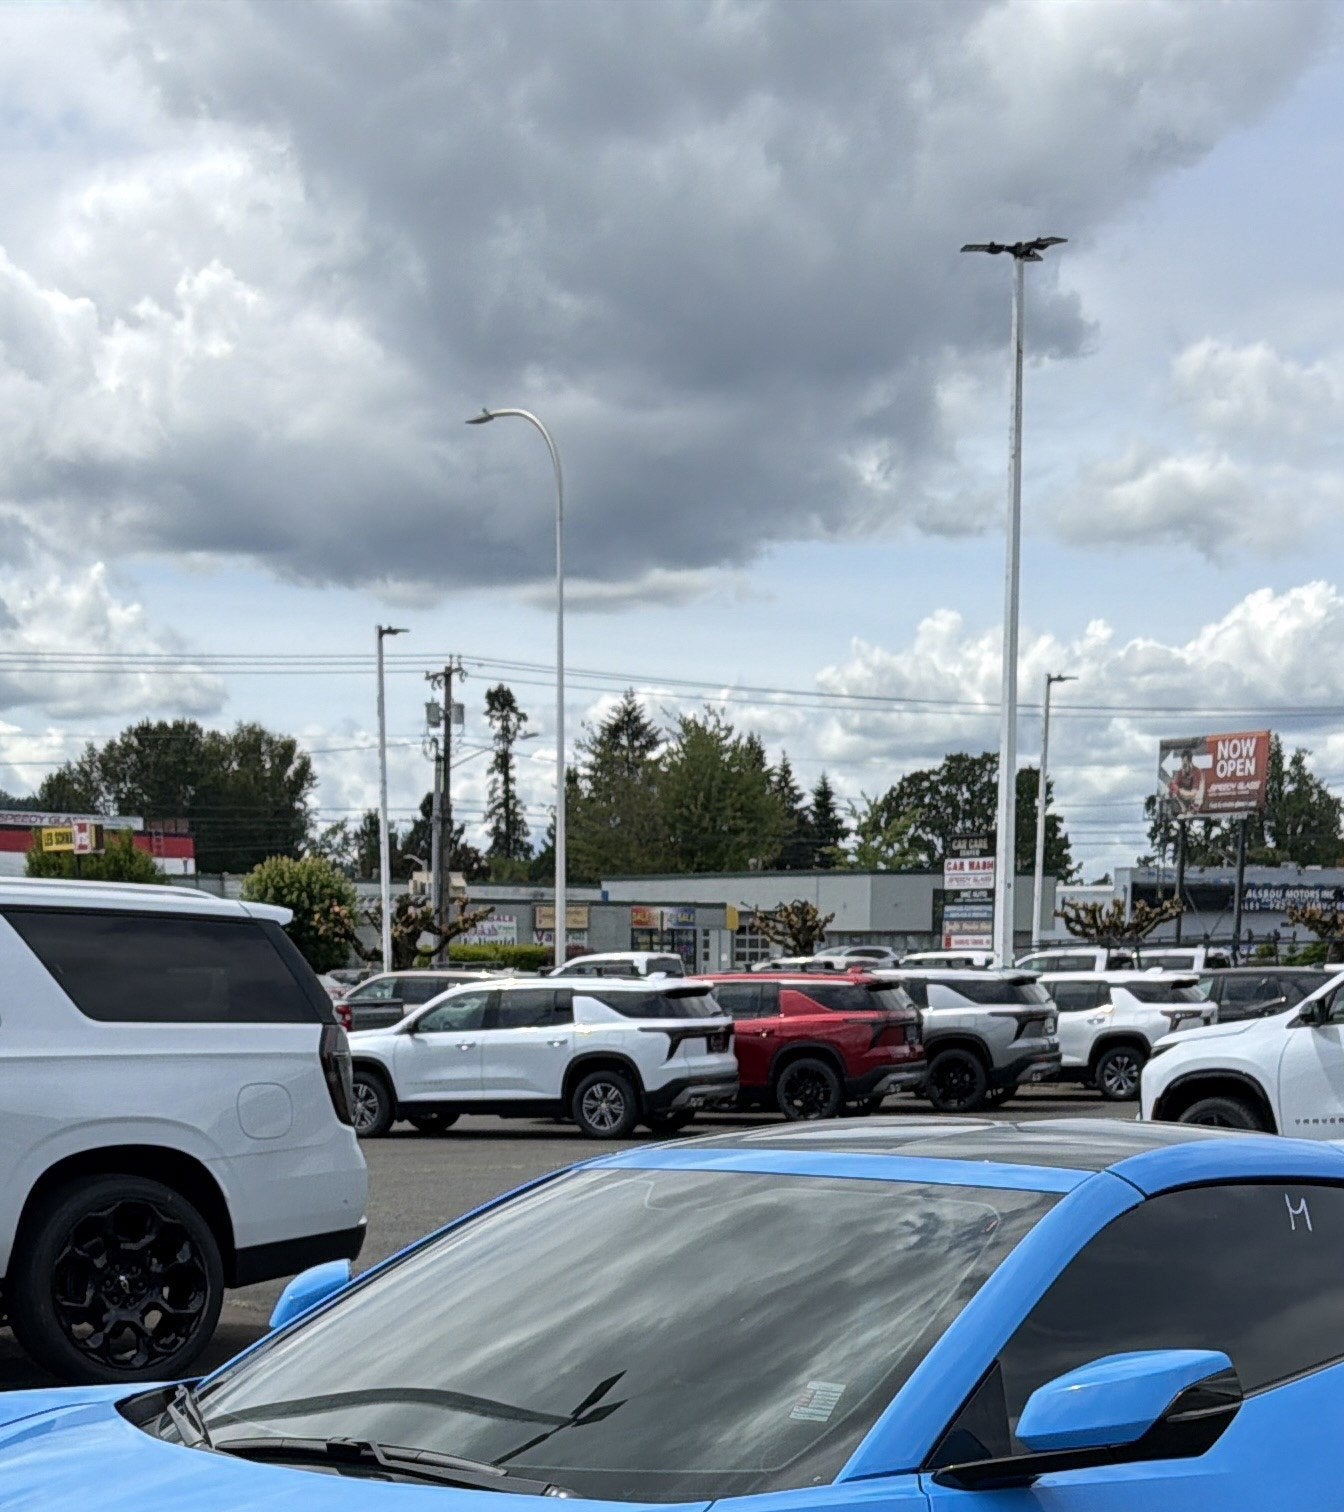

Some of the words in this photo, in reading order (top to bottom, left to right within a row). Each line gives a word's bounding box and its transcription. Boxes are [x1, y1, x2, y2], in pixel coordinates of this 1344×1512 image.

[1217, 737, 1256, 760] NOW
[1216, 758, 1256, 778] OPEN
[952, 839, 967, 850] CAR
[946, 861, 965, 872] CAR
